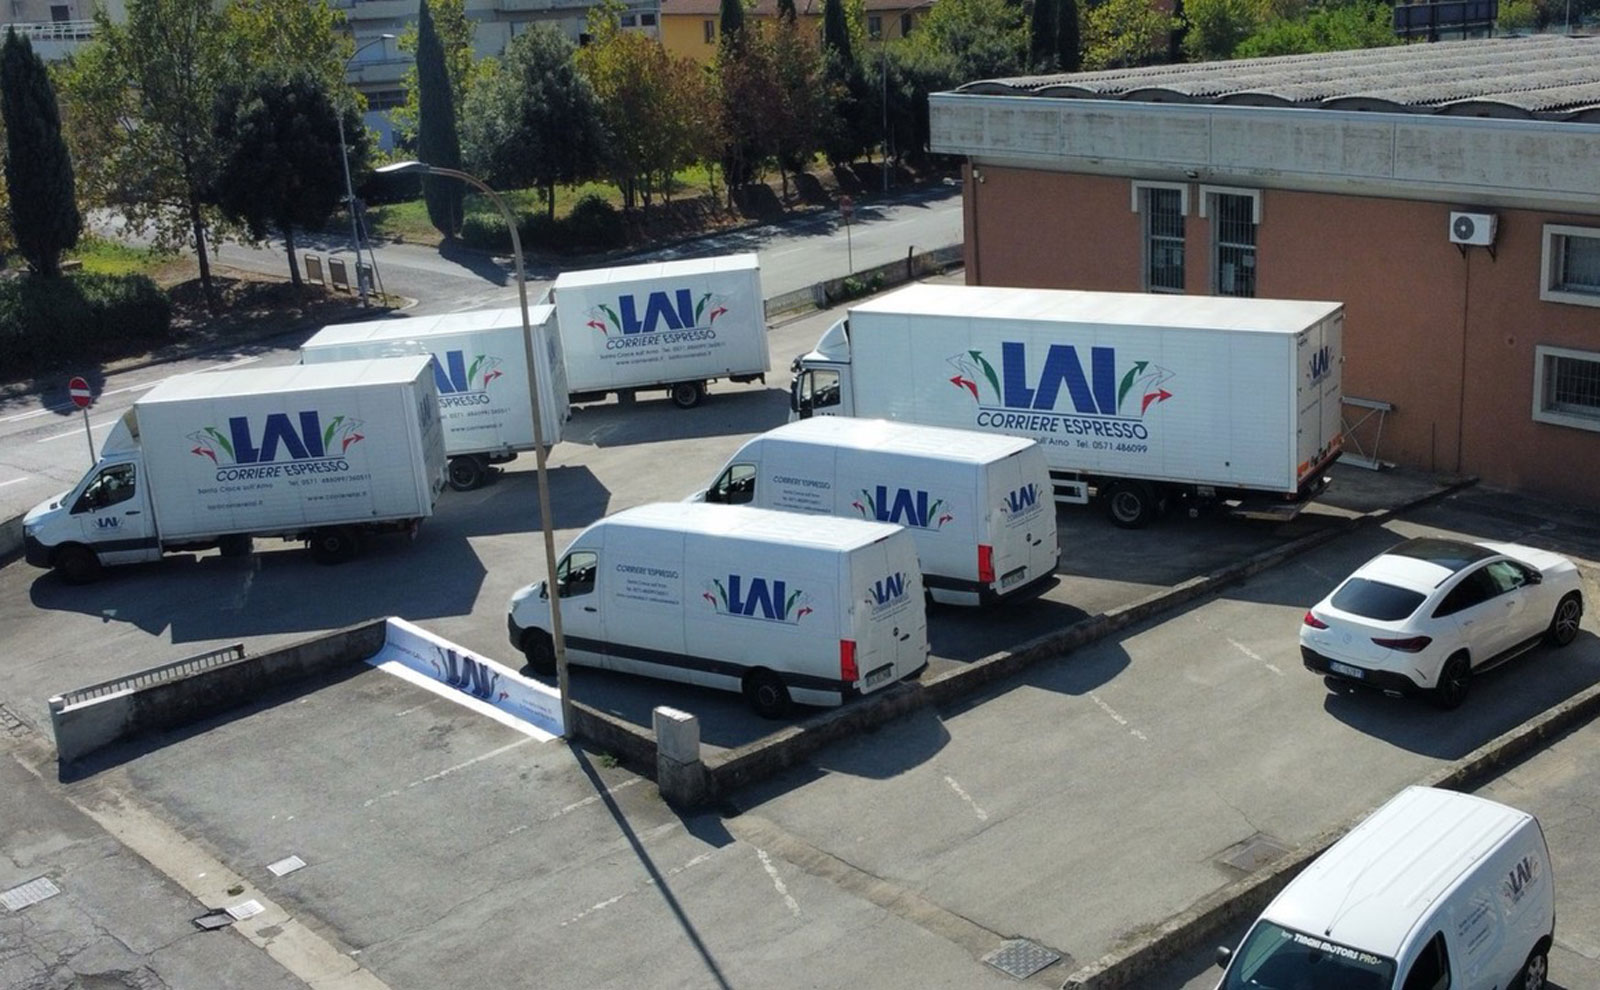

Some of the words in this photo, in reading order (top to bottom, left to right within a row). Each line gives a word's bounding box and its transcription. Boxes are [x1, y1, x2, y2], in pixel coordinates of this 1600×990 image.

[618, 288, 695, 335] LAI
[606, 334, 660, 350] CORRIERE
[662, 329, 717, 344] ESPRESSO
[1001, 341, 1117, 416] LAI
[438, 394, 490, 408] SPRESSO
[229, 410, 325, 465] LAI
[977, 411, 1060, 433] CORRIERE
[1064, 420, 1149, 441] ESPRESSO
[215, 465, 282, 482] CORRIERE
[283, 459, 350, 477] ESPRESSO
[876, 485, 929, 527] LAI
[1010, 483, 1036, 513] LAI
[98, 516, 118, 528] LAI
[728, 573, 786, 621] LAI
[875, 572, 903, 605] LAI
[446, 648, 491, 699] LAI
[1509, 857, 1532, 895] LAI
[1320, 941, 1360, 960] MOTORS
